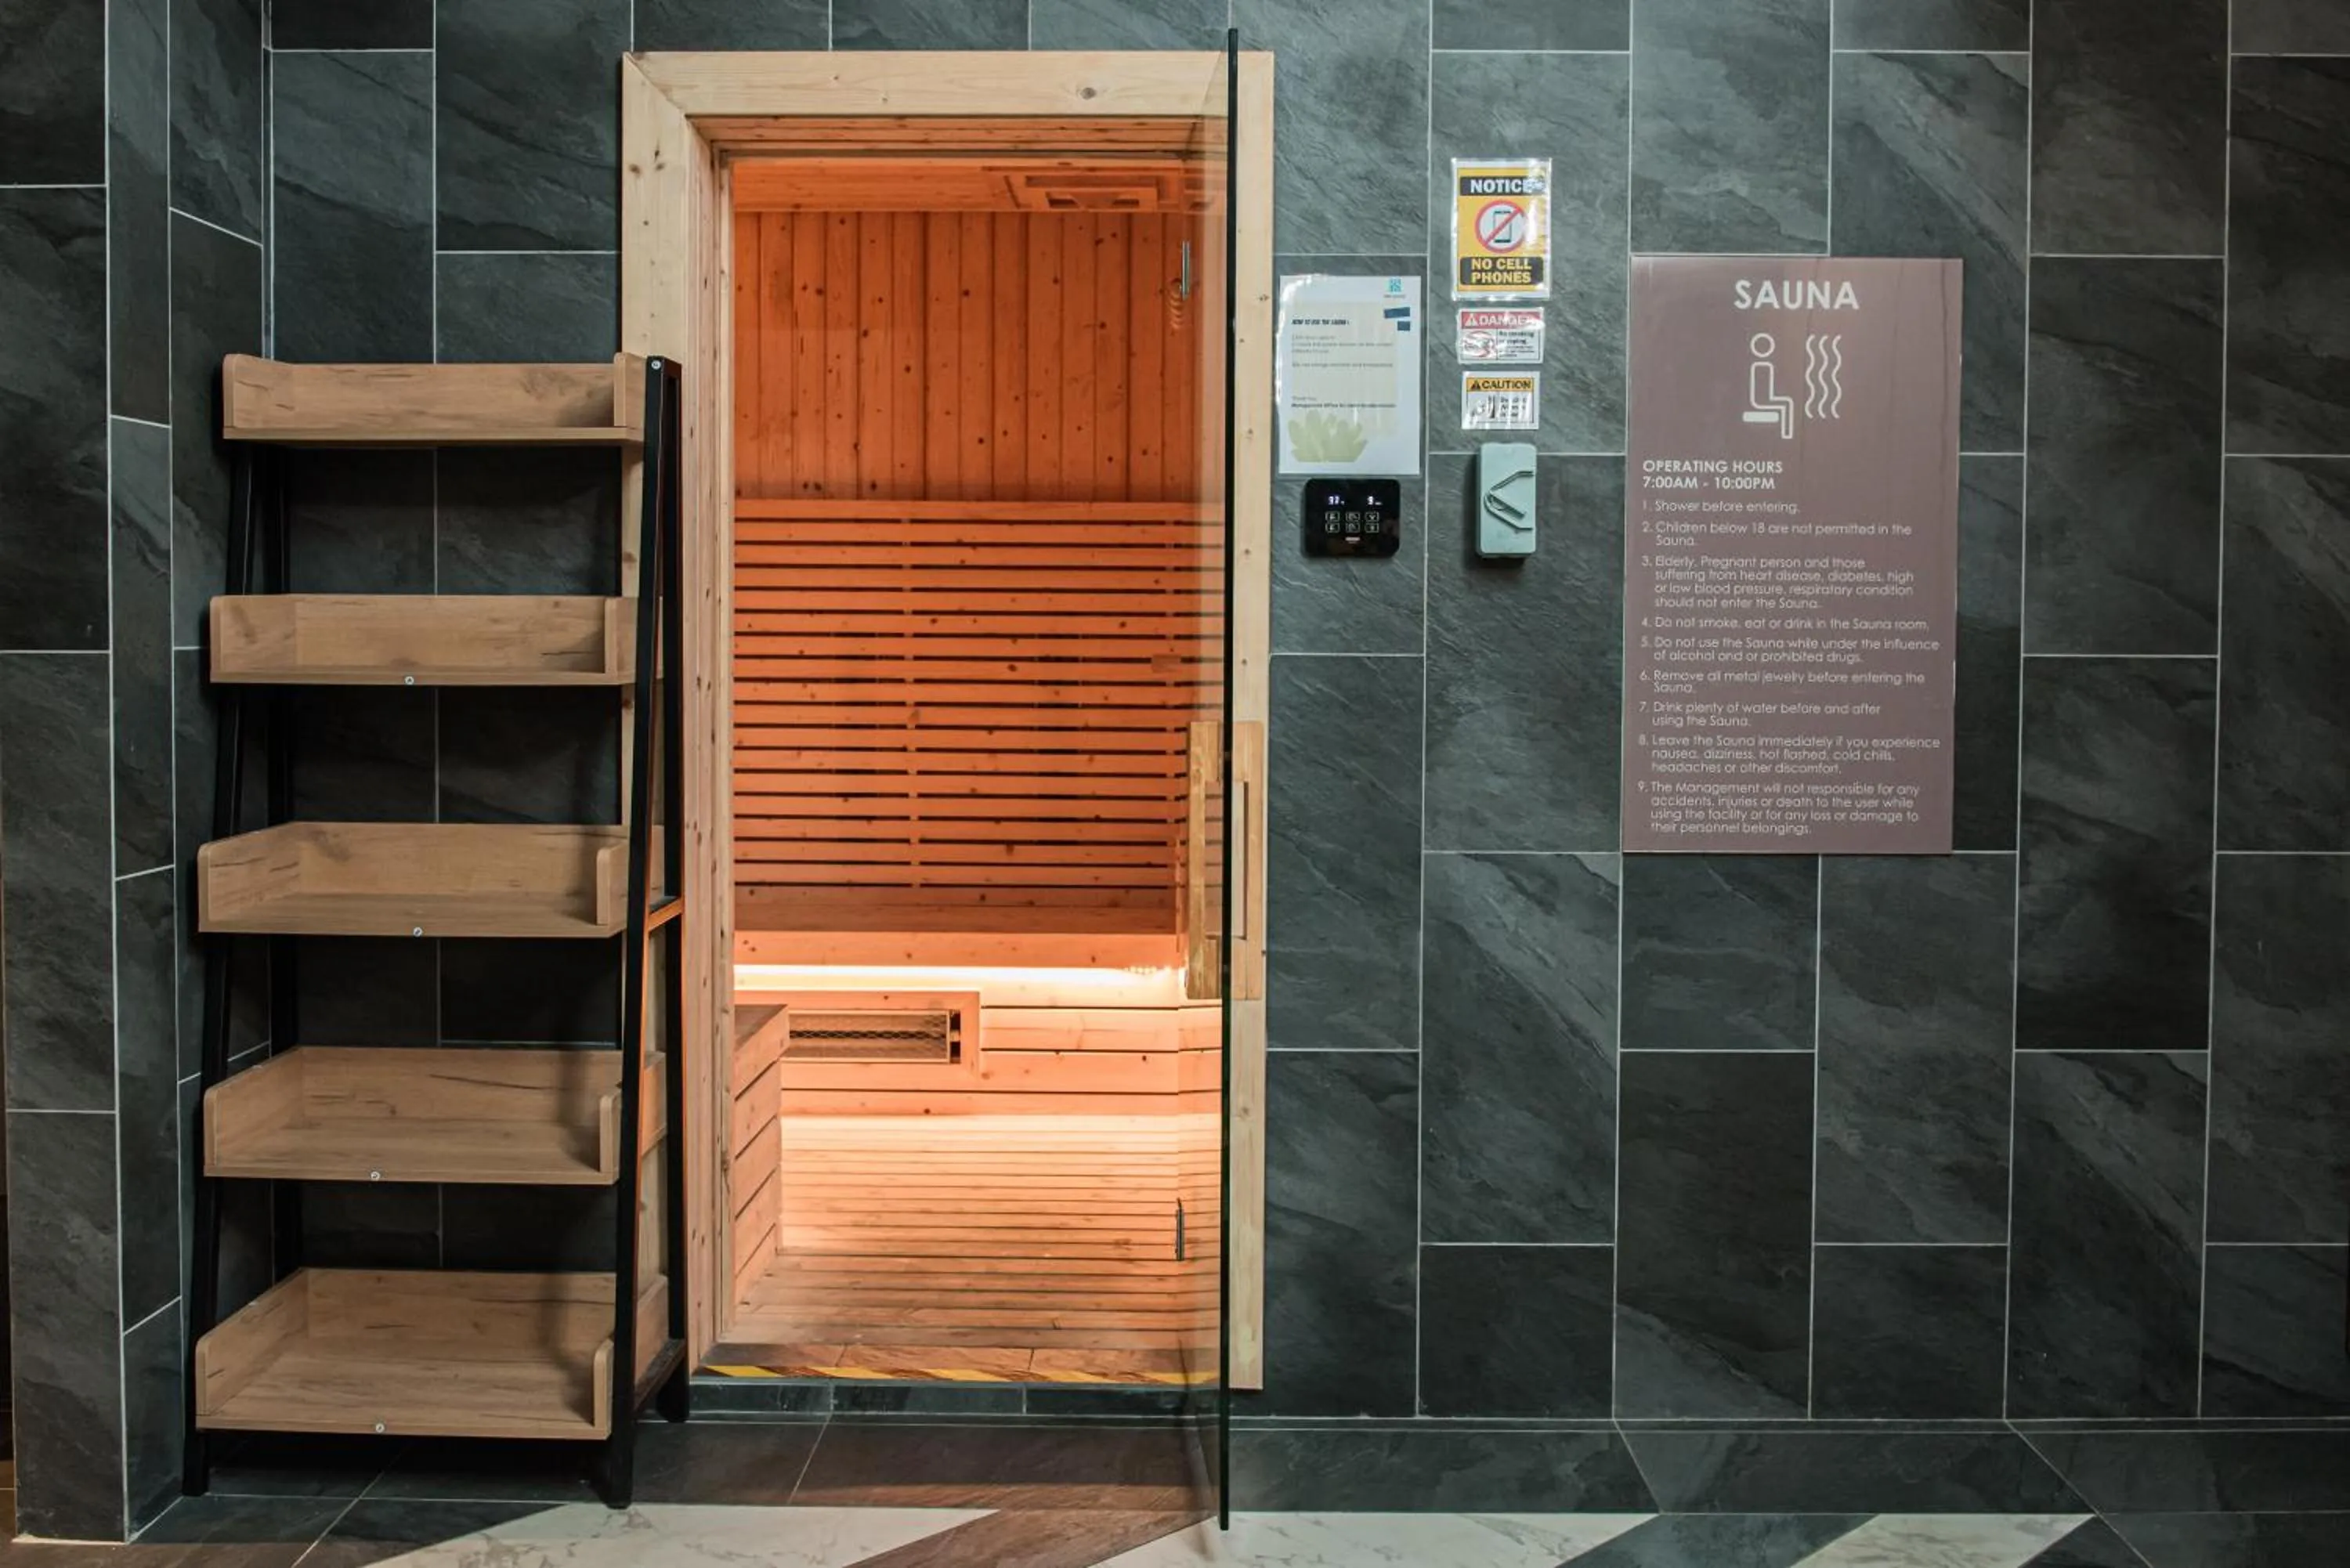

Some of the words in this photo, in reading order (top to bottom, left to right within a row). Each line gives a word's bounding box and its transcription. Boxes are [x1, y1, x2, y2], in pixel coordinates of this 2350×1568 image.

[1470, 179, 1532, 193] NOTICE
[1471, 258, 1491, 269] NO
[1496, 258, 1532, 269] CELL
[1471, 272, 1531, 283] PHONES
[1734, 280, 1859, 310] SAUNA
[1479, 315, 1535, 325] DANGE
[1643, 461, 1727, 473] OPERATING
[1733, 461, 1783, 473] HOURS
[1643, 477, 1698, 489] 7:00AM
[1716, 477, 1775, 490] 10:00PM
[1655, 500, 1699, 511] Shower
[1702, 501, 1743, 511] before
[1747, 501, 1799, 515] entering.
[1655, 522, 1706, 533] Children
[1711, 522, 1747, 533] below
[1752, 523, 1764, 533] 18
[1769, 525, 1789, 533] are
[1792, 523, 1812, 533] not
[1815, 523, 1875, 536] permitted
[1878, 524, 1888, 534] in
[1892, 524, 1912, 535] the
[1656, 536, 1697, 546] Sauna.
[1701, 556, 1756, 569] Pregnant
[1760, 558, 1800, 569] person
[1805, 557, 1829, 568] and
[1832, 558, 1865, 569] those
[1655, 569, 1705, 582] suffering
[1709, 569, 1737, 580] from
[1740, 570, 1771, 580] heart
[1888, 571, 1914, 584] high
[1670, 583, 1690, 593] low
[1694, 583, 1730, 594] blood
[1789, 584, 1853, 597] respiratory
[1856, 584, 1913, 595] condition
[1654, 597, 1694, 607] should
[1697, 597, 1718, 608] not
[1721, 598, 1752, 608] enter
[1756, 598, 1775, 608] the
[1655, 617, 1672, 627] Do
[1676, 617, 1695, 627] not
[1745, 618, 1765, 628] eat
[1769, 620, 1781, 629] or
[1784, 619, 1813, 629] drink
[1817, 620, 1825, 629] in
[1831, 619, 1849, 629] the
[1853, 618, 1891, 630] Sauna
[1654, 637, 1672, 648] Do
[1676, 638, 1695, 648] not
[1698, 639, 1719, 648] use
[1723, 638, 1742, 648] the
[1745, 638, 1784, 649] Sauna
[1788, 638, 1817, 649] while
[1822, 638, 1856, 649] under
[1862, 639, 1880, 649] the
[1884, 638, 1940, 651] influence
[1654, 650, 1666, 660] of
[1670, 650, 1715, 661] alcohol
[1718, 651, 1742, 661] and
[1746, 652, 1757, 661] or
[1761, 651, 1823, 663] prohibited
[1654, 670, 1704, 681] Remove
[1708, 670, 1720, 681] all
[1724, 671, 1759, 681] metal
[1808, 671, 1848, 682] before
[1851, 672, 1902, 685] entering
[1906, 673, 1925, 683] the
[1654, 702, 1682, 712] Drink
[1686, 703, 1723, 714] plenty
[1726, 702, 1740, 713] of
[1743, 703, 1777, 714] water
[1781, 703, 1820, 714] before
[1824, 703, 1849, 714] and
[1853, 703, 1880, 714] after
[1653, 716, 1683, 727] using
[1687, 715, 1706, 726] the
[1710, 715, 1751, 726] Sauna.
[1653, 735, 1690, 746] Leave
[1694, 735, 1713, 746] the
[1716, 735, 1755, 746] Sauna
[1758, 736, 1831, 749] immediately
[1835, 736, 1843, 746] if
[1846, 739, 1868, 749] you
[1871, 738, 1940, 748] experience
[1759, 750, 1779, 759] hot
[1833, 750, 1860, 761] cold
[1651, 762, 1721, 773] headaches
[1725, 764, 1736, 773] or
[1741, 763, 1771, 773] other
[1651, 781, 1672, 792] The
[1676, 782, 1759, 794] Management
[1764, 783, 1780, 793] will
[1784, 783, 1804, 793] not
[1808, 782, 1874, 795] responsible
[1878, 783, 1894, 793] for
[1896, 786, 1919, 797] any
[1719, 797, 1757, 808] injuries
[1761, 798, 1772, 807] or
[1776, 797, 1813, 807] death
[1817, 797, 1828, 807] to
[1832, 797, 1852, 807] the
[1856, 799, 1879, 808] user
[1883, 798, 1913, 808] while
[1651, 810, 1681, 821] using
[1686, 810, 1705, 819] the
[1708, 810, 1746, 821] facility
[1751, 811, 1762, 819] or
[1766, 810, 1781, 819] for
[1785, 811, 1807, 822] any
[1810, 811, 1831, 821] loss
[1835, 812, 1846, 821] or
[1849, 811, 1902, 823] damage
[1907, 812, 1918, 822] to
[1651, 822, 1676, 833] their
[1680, 822, 1738, 835] personnel
